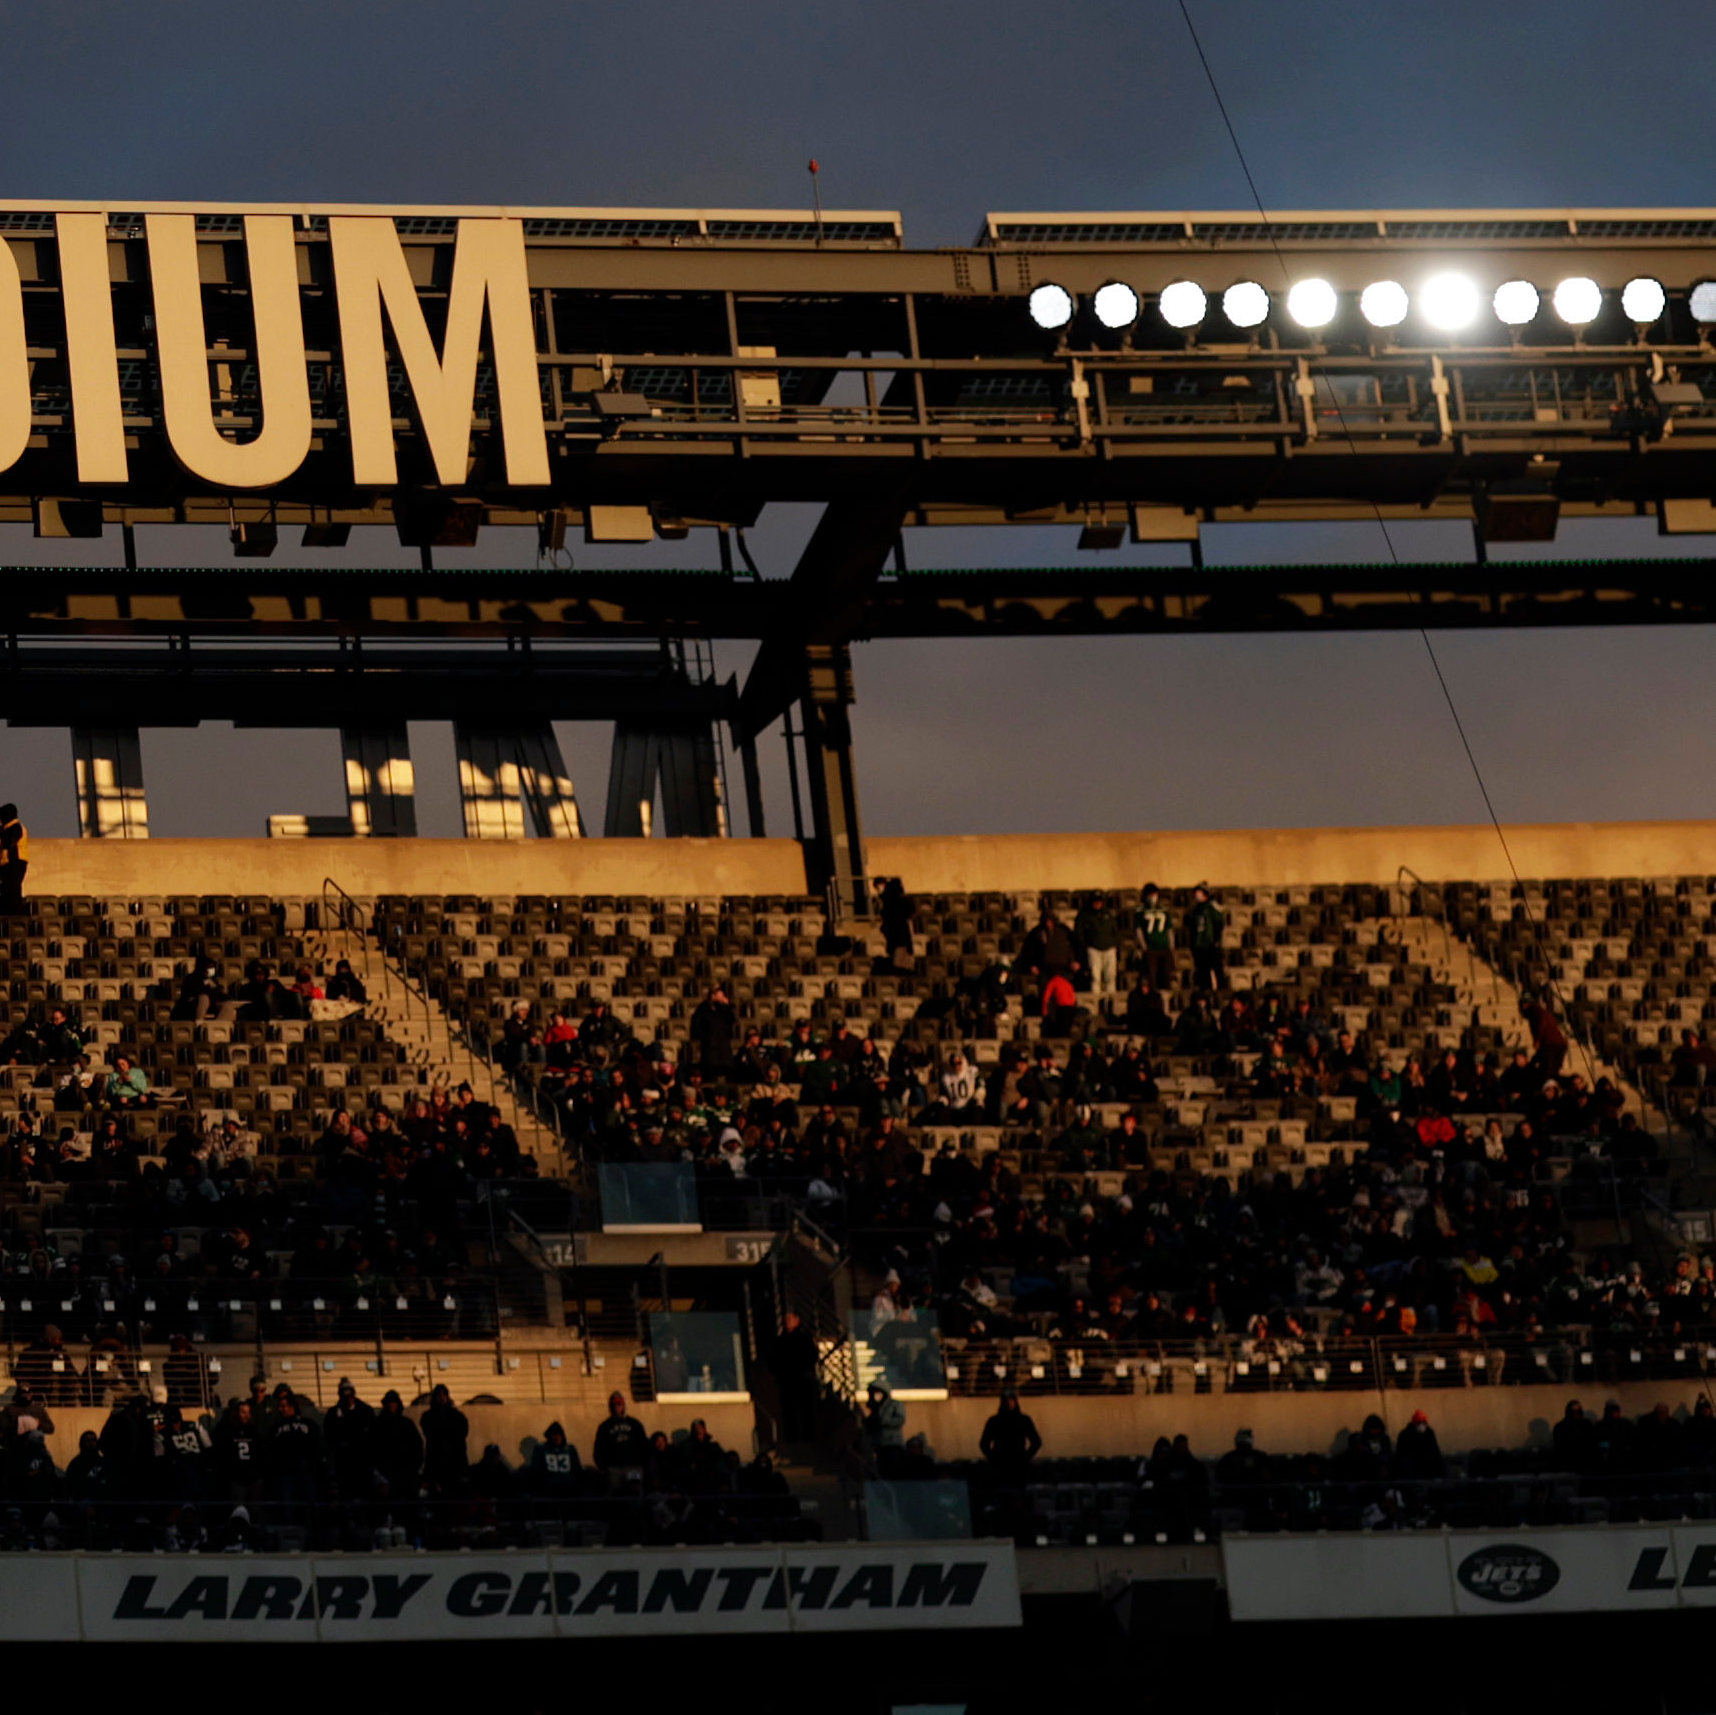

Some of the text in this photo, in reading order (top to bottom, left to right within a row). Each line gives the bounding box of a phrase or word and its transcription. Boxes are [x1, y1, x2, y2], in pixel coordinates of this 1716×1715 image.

[1143, 912, 1167, 934] 77
[951, 1078, 969, 1099] 10
[237, 1441, 250, 1461] 2
[544, 1452, 572, 1473] 93
[1470, 1562, 1543, 1584] JETS
[112, 1574, 433, 1620] LARRY
[446, 1562, 988, 1618] GRANTHAM
